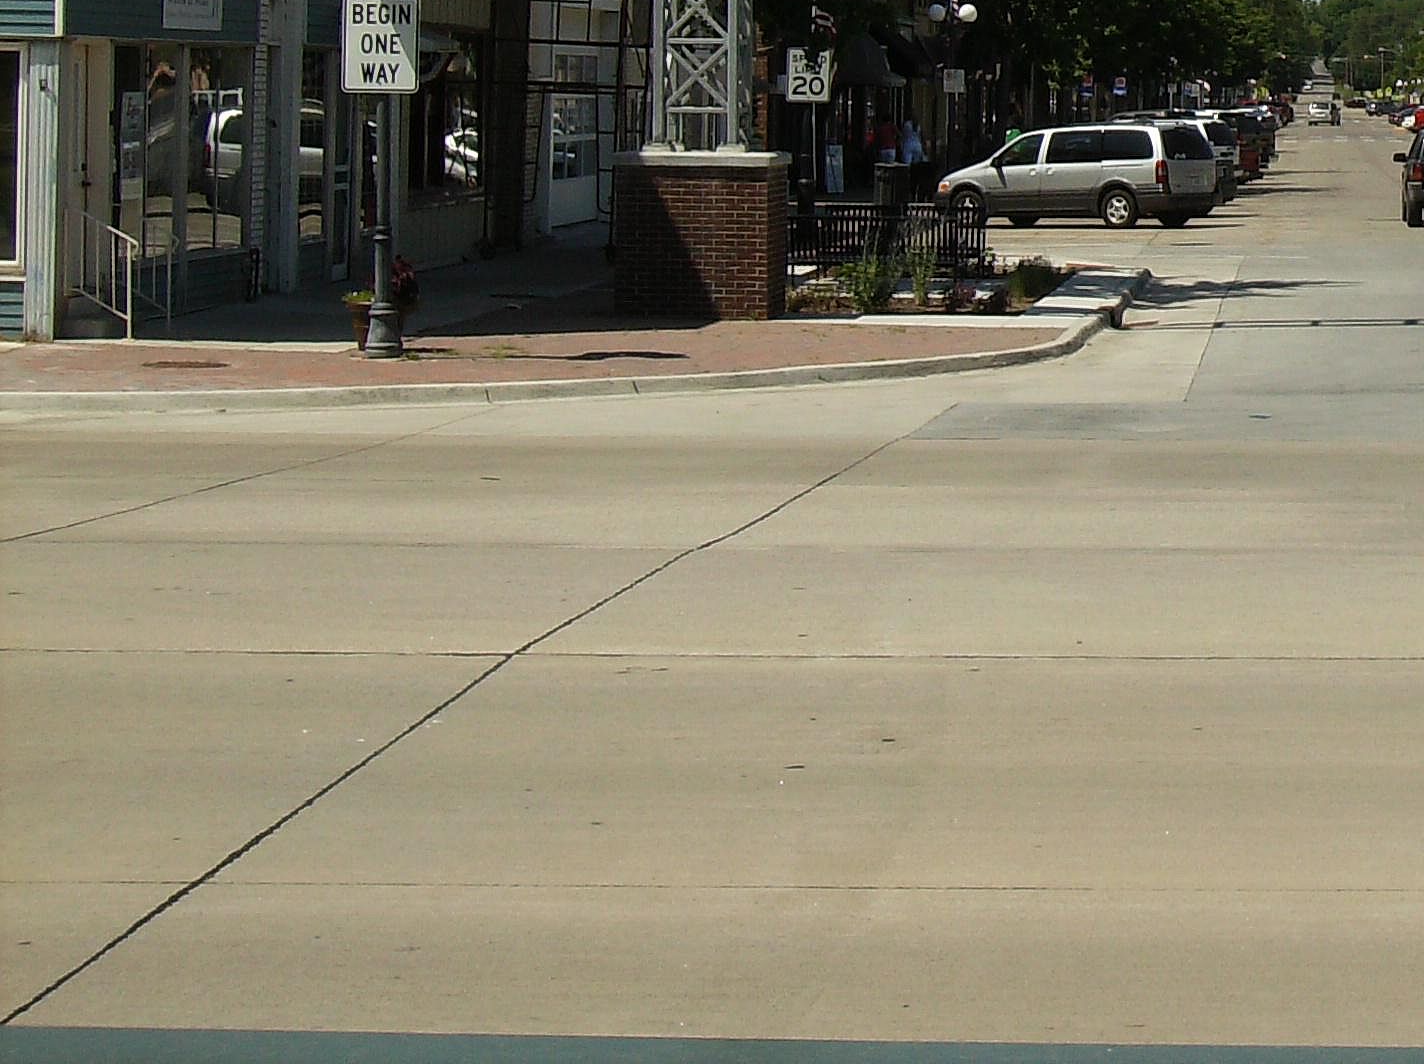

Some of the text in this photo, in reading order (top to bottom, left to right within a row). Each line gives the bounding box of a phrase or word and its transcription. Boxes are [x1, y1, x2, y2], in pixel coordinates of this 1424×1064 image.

[352, 3, 412, 25] BEGIN
[361, 33, 401, 55] ONE
[360, 62, 400, 84] WAY
[791, 76, 825, 96] 20
